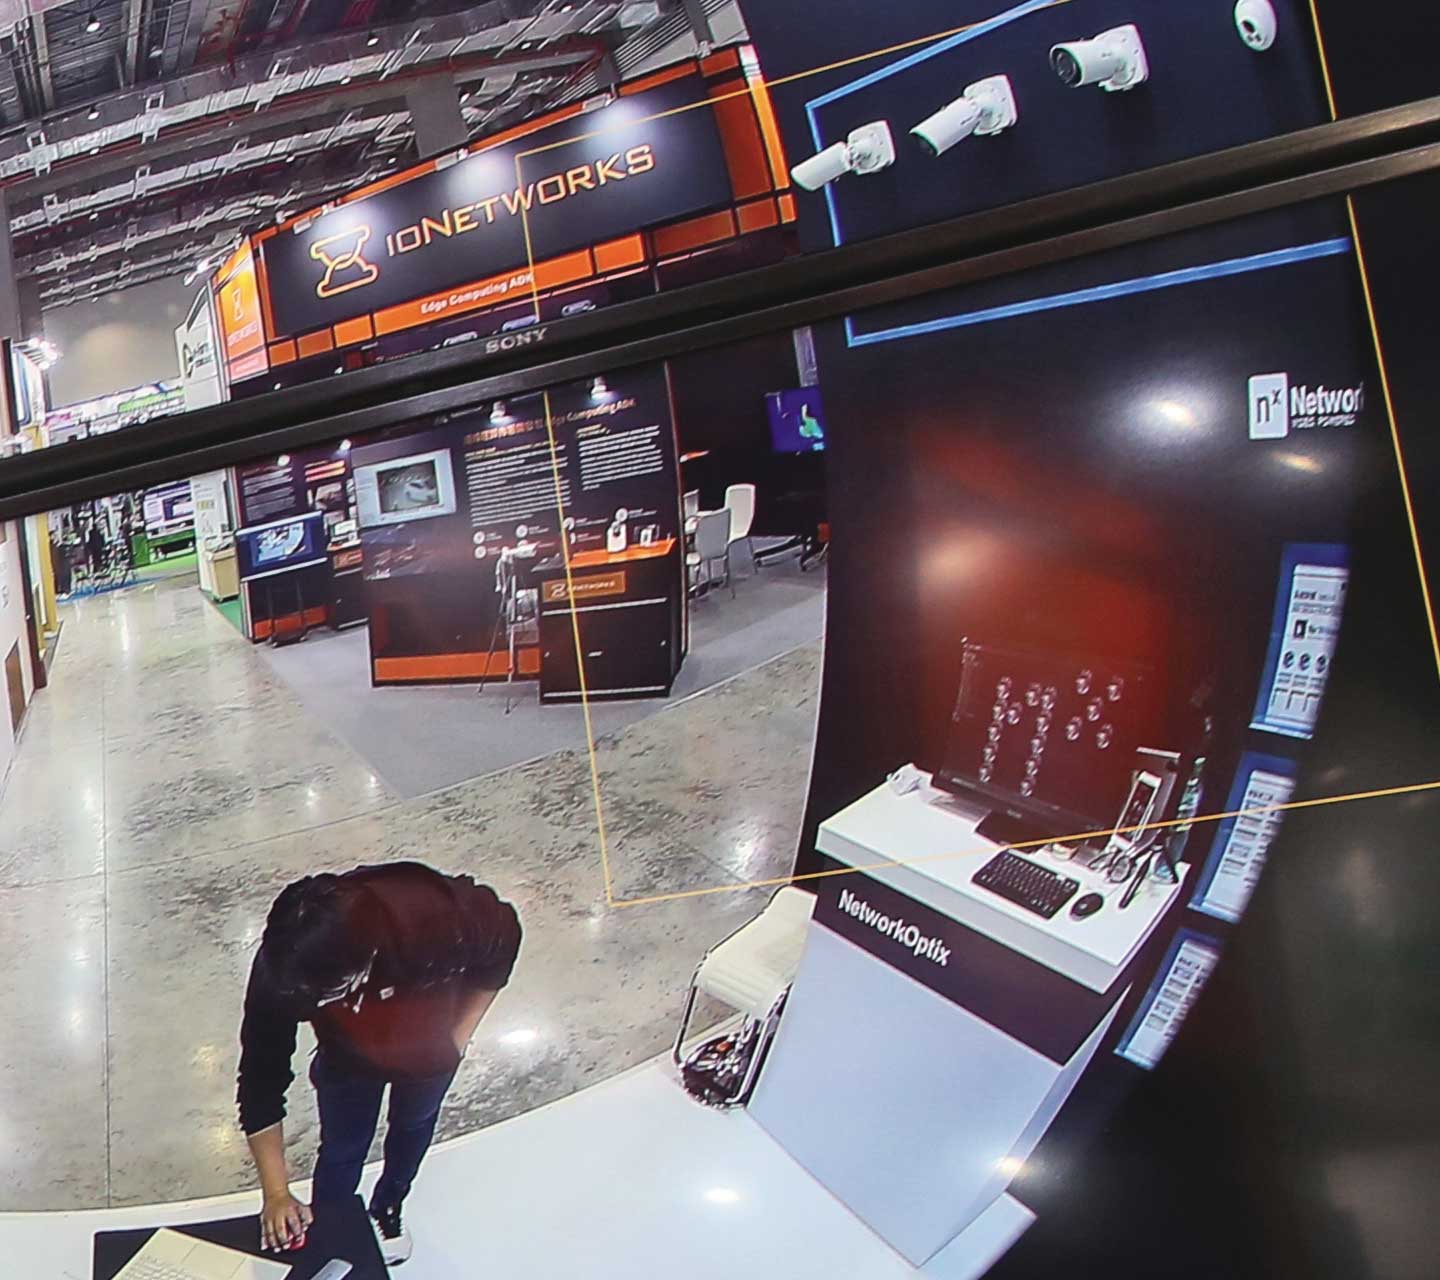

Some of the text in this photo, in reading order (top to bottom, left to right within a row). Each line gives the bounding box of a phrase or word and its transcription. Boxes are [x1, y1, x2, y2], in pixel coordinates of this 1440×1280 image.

[449, 280, 509, 308] Computing
[484, 327, 548, 355] SONY
[1290, 381, 1365, 417] Networ
[838, 888, 952, 967] NetworkOptix
